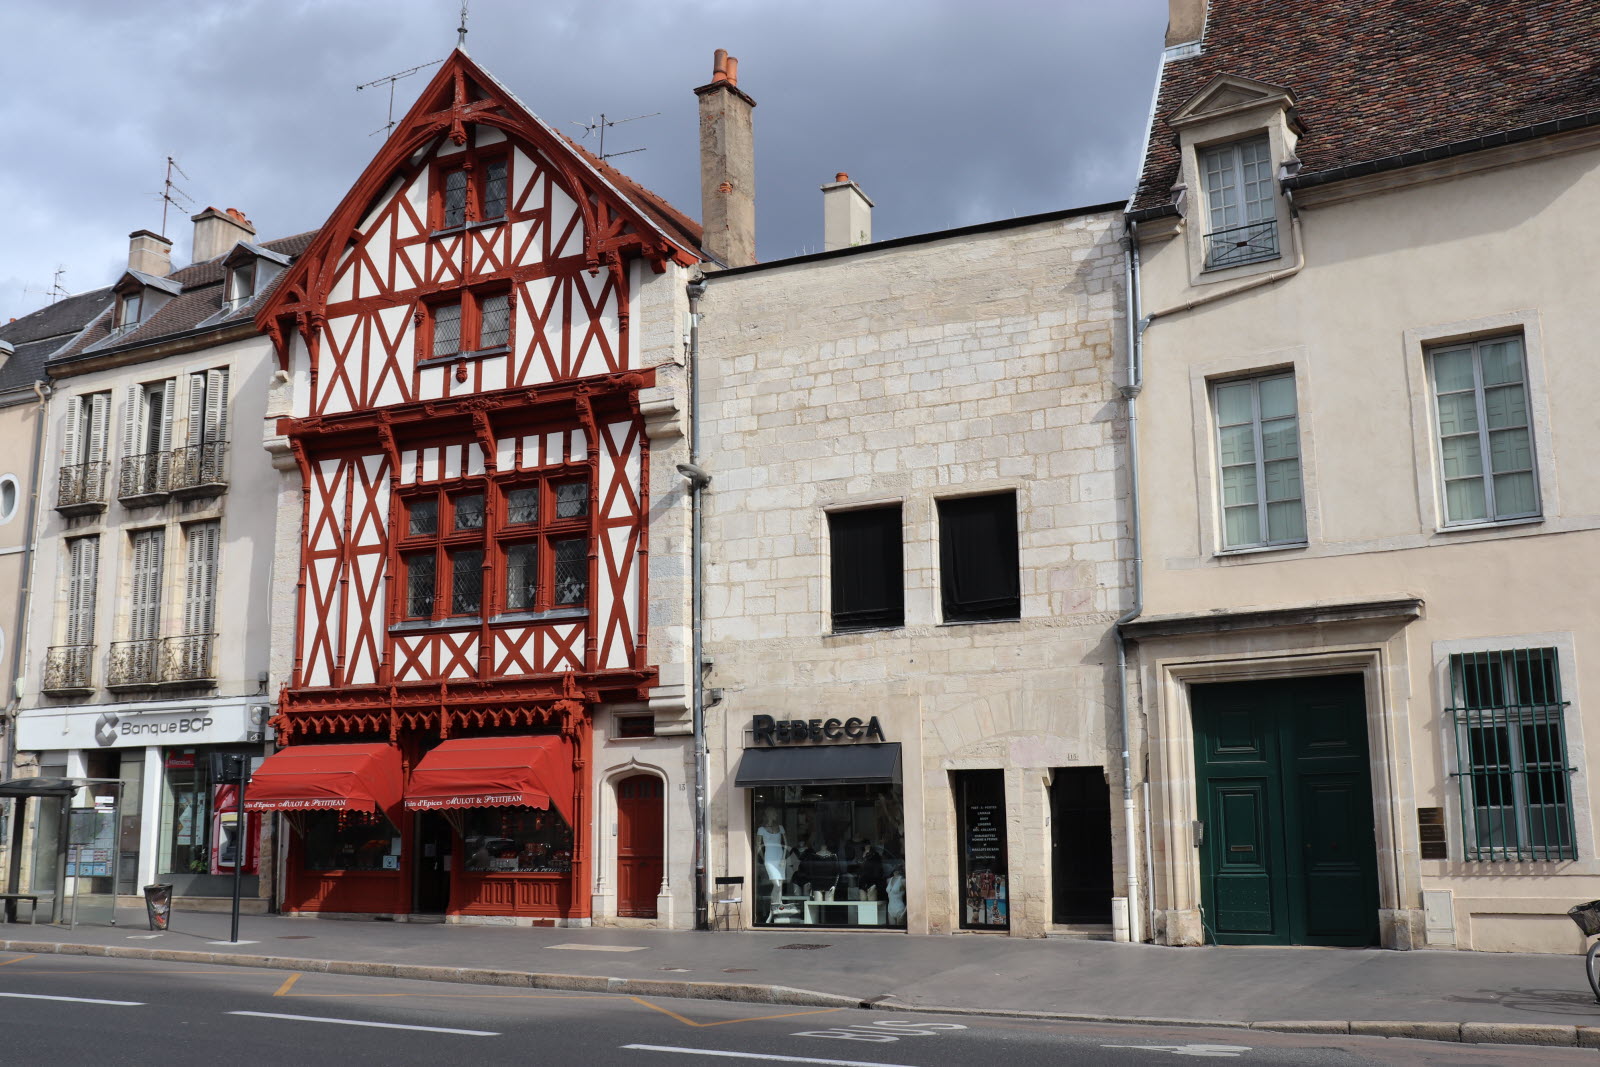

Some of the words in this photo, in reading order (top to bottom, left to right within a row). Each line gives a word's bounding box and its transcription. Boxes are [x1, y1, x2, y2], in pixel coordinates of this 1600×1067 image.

[121, 722, 177, 736] Banque
[179, 717, 213, 733] BCP
[753, 714, 886, 746] REBECCA
[679, 783, 686, 791] 13
[445, 797, 475, 805] MULOT
[483, 795, 522, 804] PETITJEAN
[789, 1020, 967, 1042] BUS
